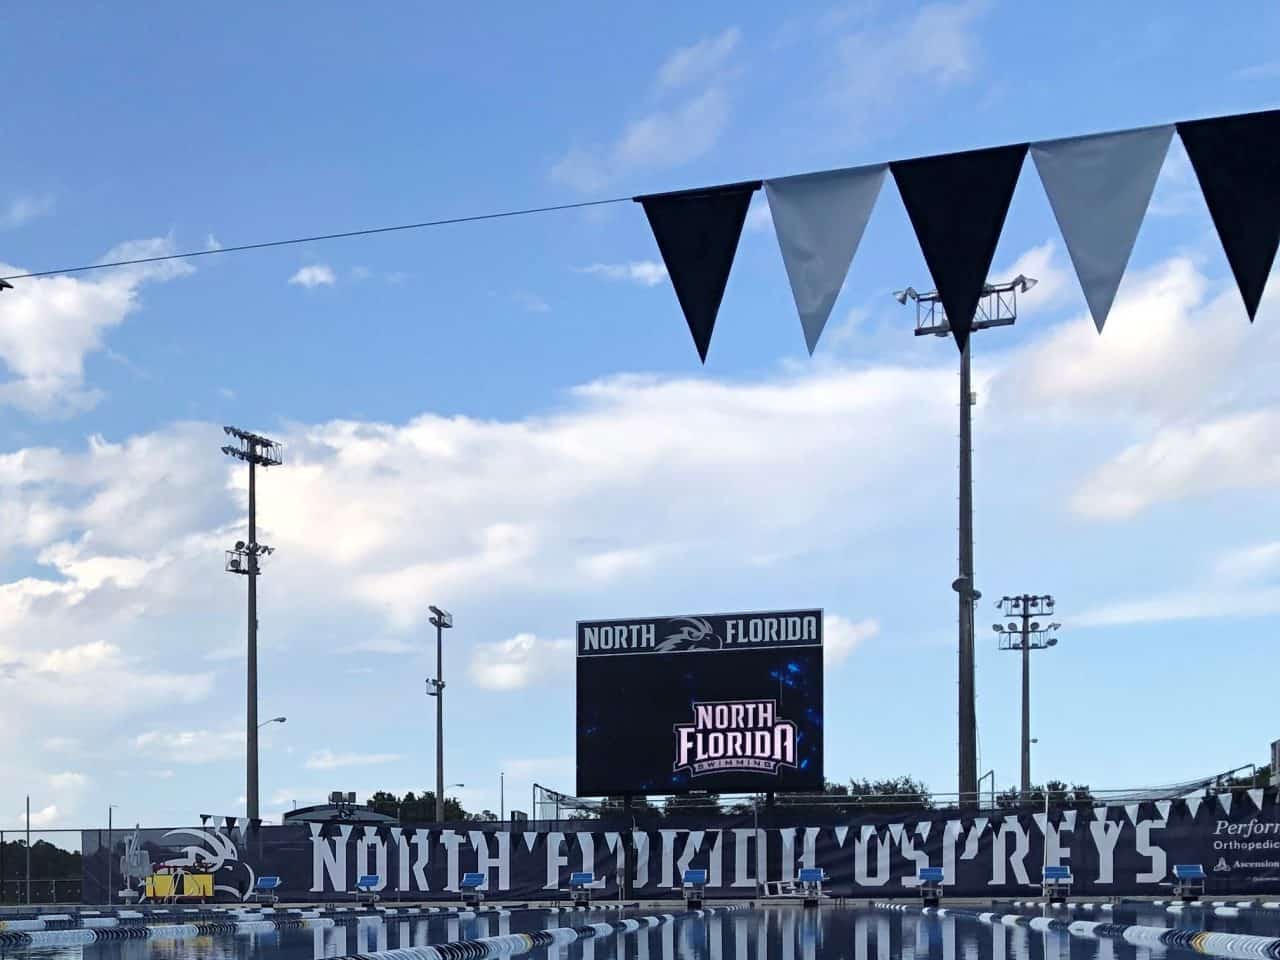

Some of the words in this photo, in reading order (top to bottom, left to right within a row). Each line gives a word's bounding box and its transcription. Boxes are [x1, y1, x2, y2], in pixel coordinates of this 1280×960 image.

[583, 624, 656, 650] NORTH
[725, 616, 817, 643] FLORIDA
[696, 703, 773, 730] NORTH
[678, 724, 794, 767] FLORIDA
[309, 828, 511, 892] NORTH
[854, 817, 1168, 887] OSPREYS
